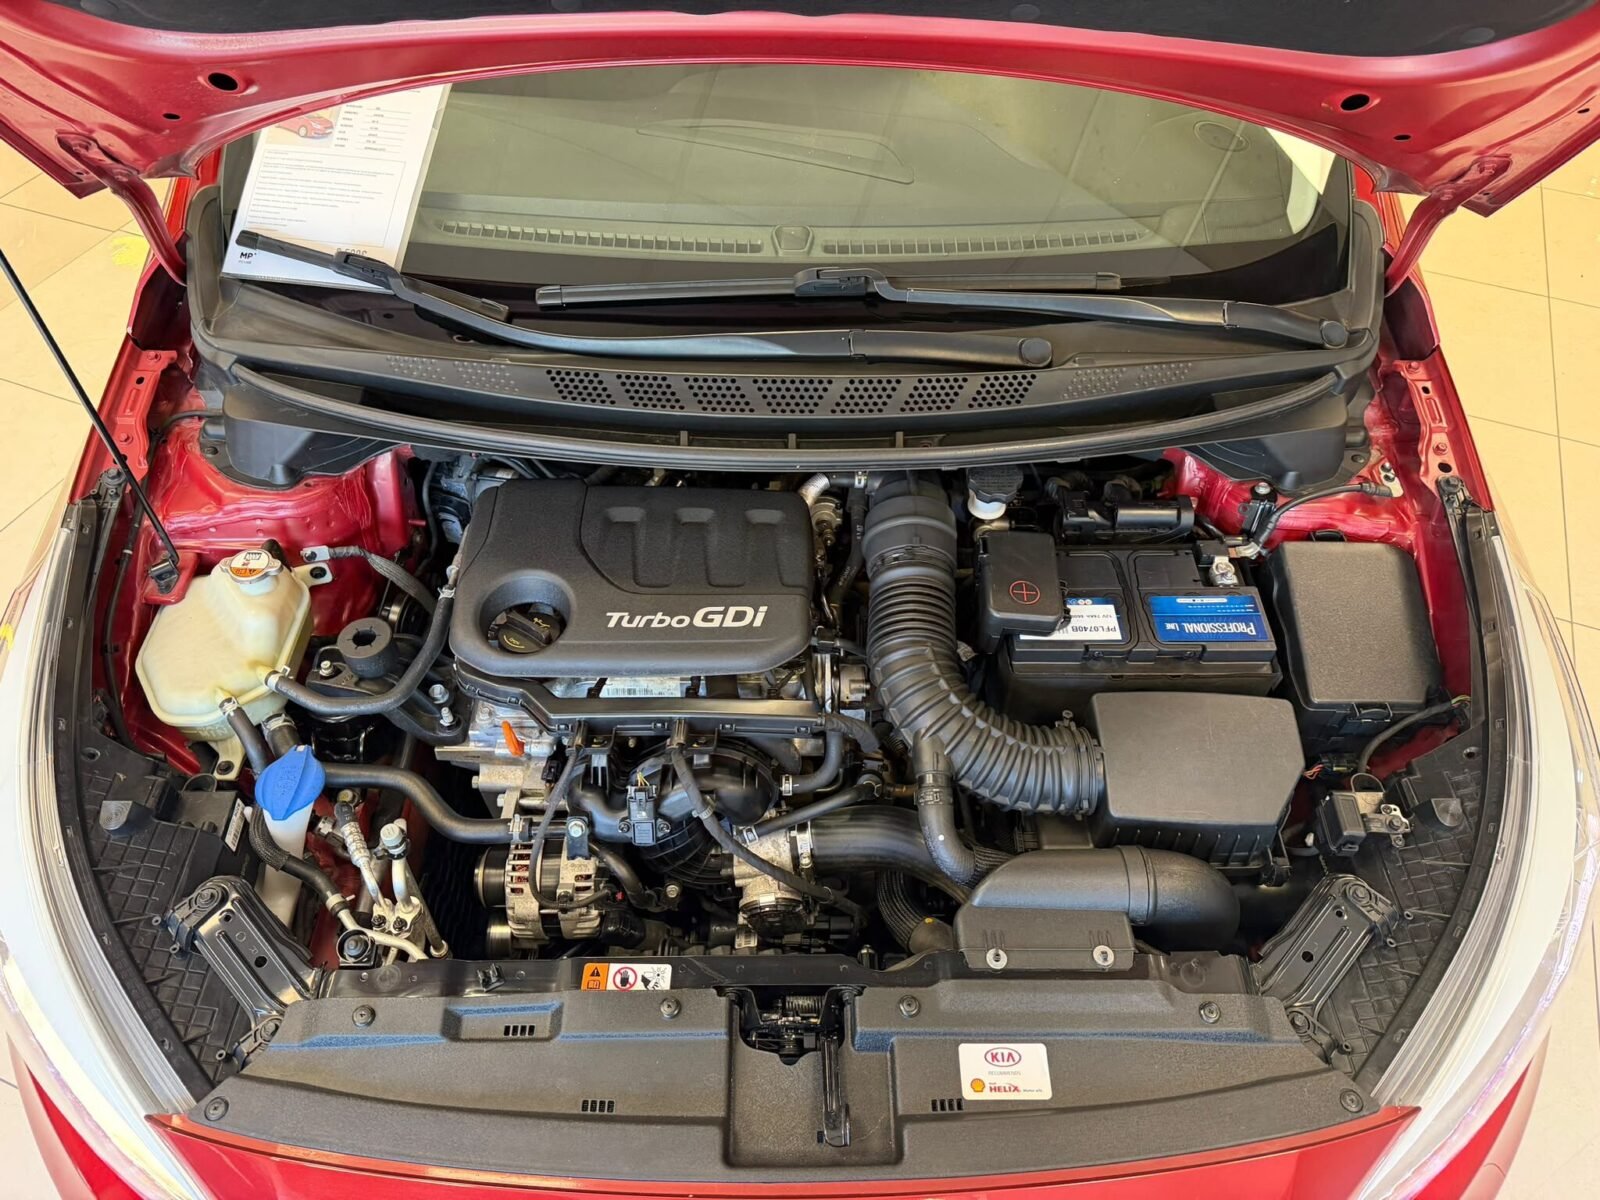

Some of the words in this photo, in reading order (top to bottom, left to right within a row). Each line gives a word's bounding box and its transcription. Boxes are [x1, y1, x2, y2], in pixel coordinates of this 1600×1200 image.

[1181, 622, 1257, 636] PROFESSIONAL
[990, 1051, 1016, 1063] KIA
[989, 1085, 1021, 1093] HELIX
